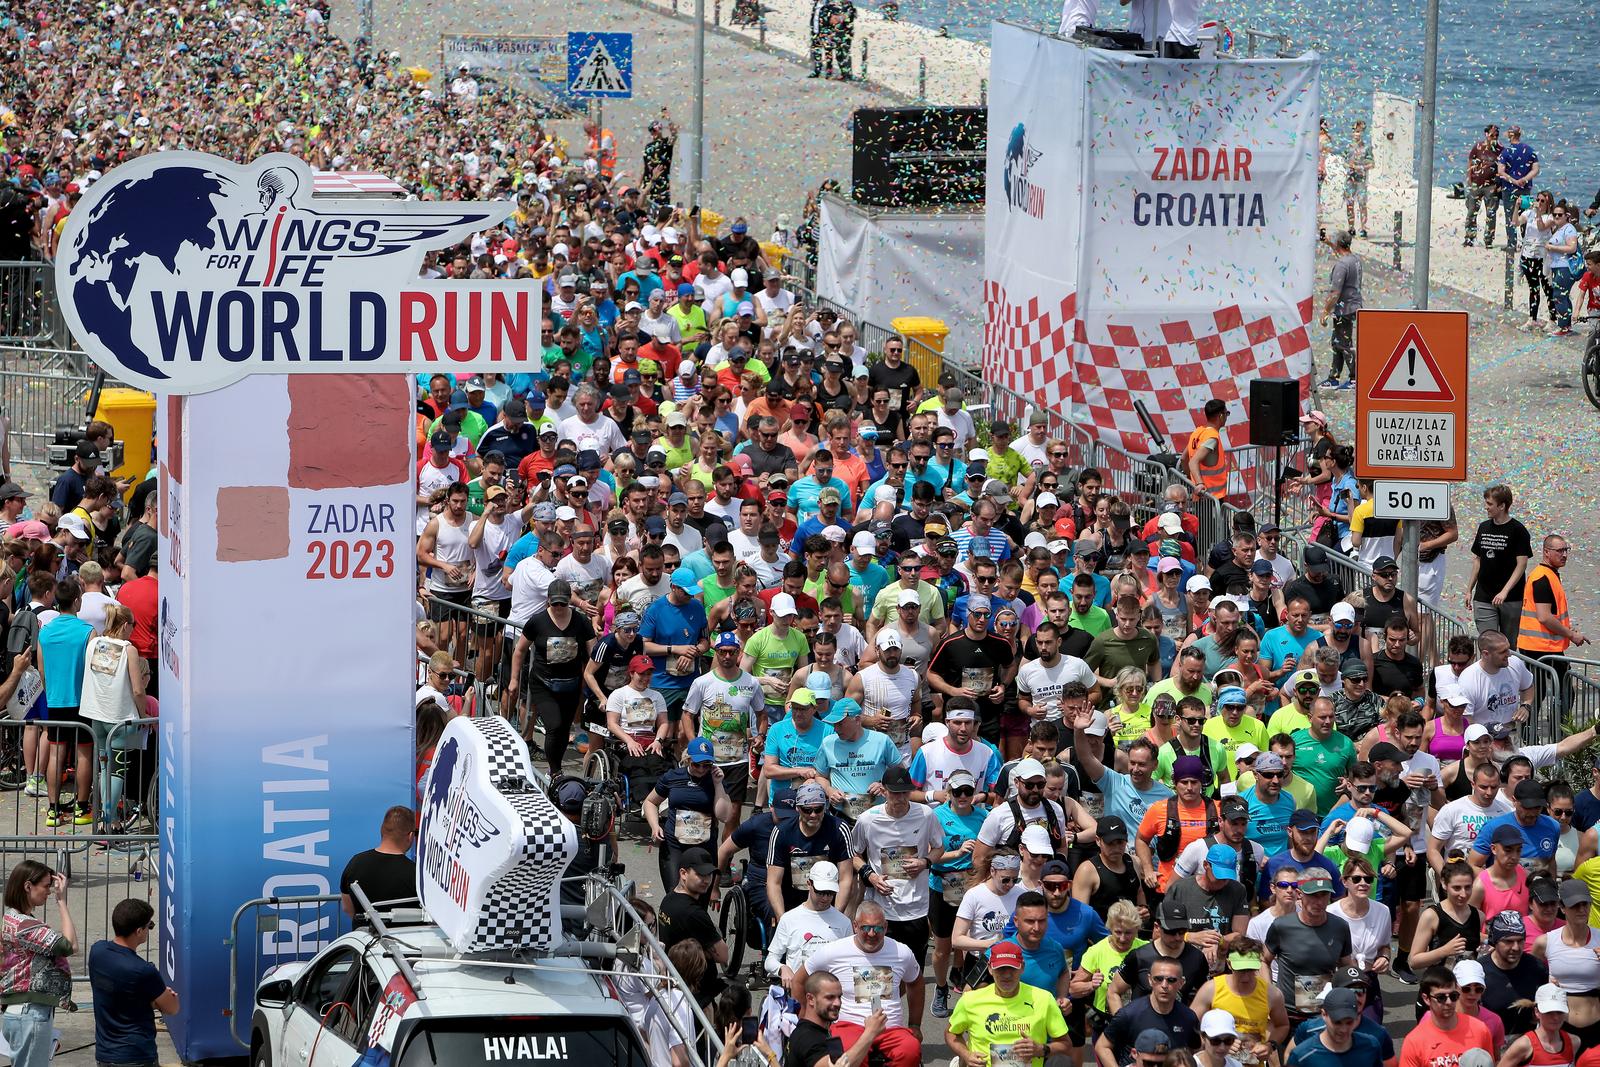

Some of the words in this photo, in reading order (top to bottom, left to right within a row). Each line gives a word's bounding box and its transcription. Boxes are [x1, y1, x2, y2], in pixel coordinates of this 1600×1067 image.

[1151, 147, 1253, 182] ZADAR
[1133, 192, 1266, 227] CROATIA
[217, 206, 381, 251] WINGS
[206, 255, 242, 270] FOR
[1375, 417, 1447, 431] ULAZ/IZLAZ
[1381, 433, 1421, 446] VOZILA
[1427, 434, 1441, 446] SA
[1377, 447, 1445, 462] GRAIŠTA
[1388, 491, 1413, 509] 50
[1418, 496, 1435, 510] m
[307, 503, 395, 534] ZADAR
[306, 539, 395, 580] 2023
[1037, 684, 1063, 693] zada
[1039, 690, 1063, 698] TRIATLO
[1462, 815, 1493, 824] RAIN
[164, 721, 176, 983] CROATIA
[261, 733, 331, 956] ROATIA
[483, 1036, 568, 1061] HVALA!
